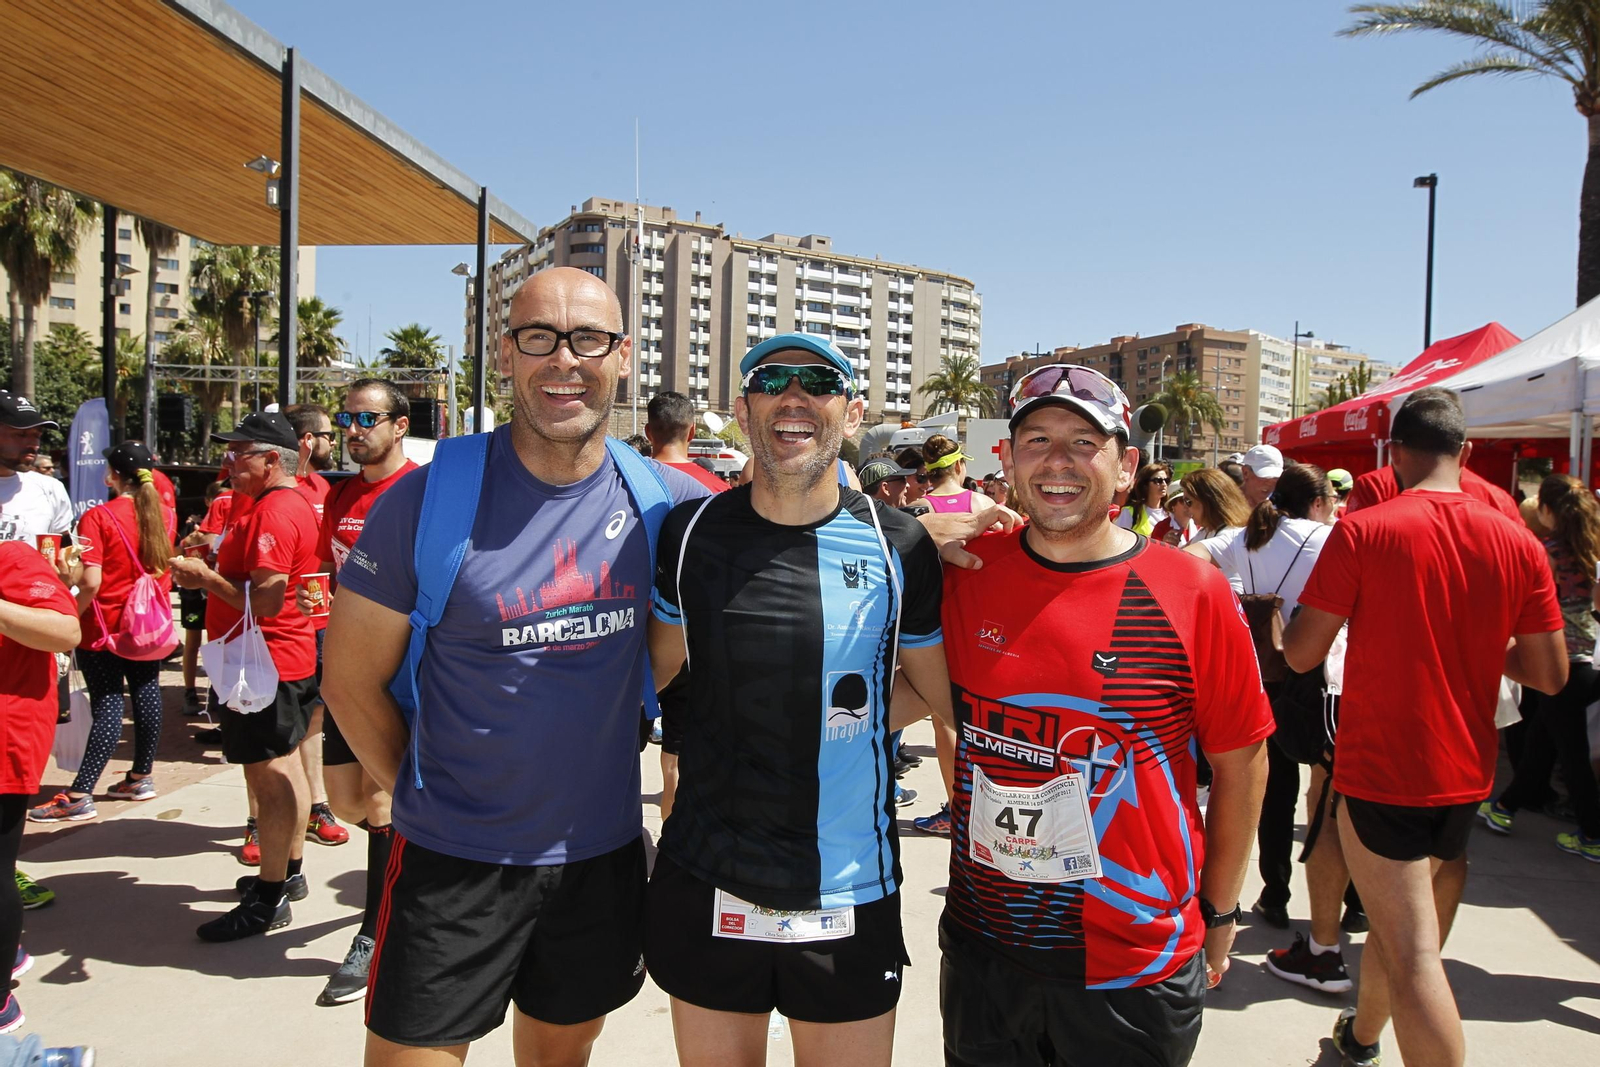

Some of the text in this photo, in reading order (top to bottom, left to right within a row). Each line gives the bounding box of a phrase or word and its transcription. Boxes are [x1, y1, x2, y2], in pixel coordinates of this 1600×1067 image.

[545, 603, 594, 619] Zurich Marató
[502, 607, 635, 646] BARCELONA
[563, 643, 585, 651] marzo
[962, 692, 1055, 748] TRI
[995, 807, 1043, 837] 47
[1005, 836, 1037, 847] CARPE
